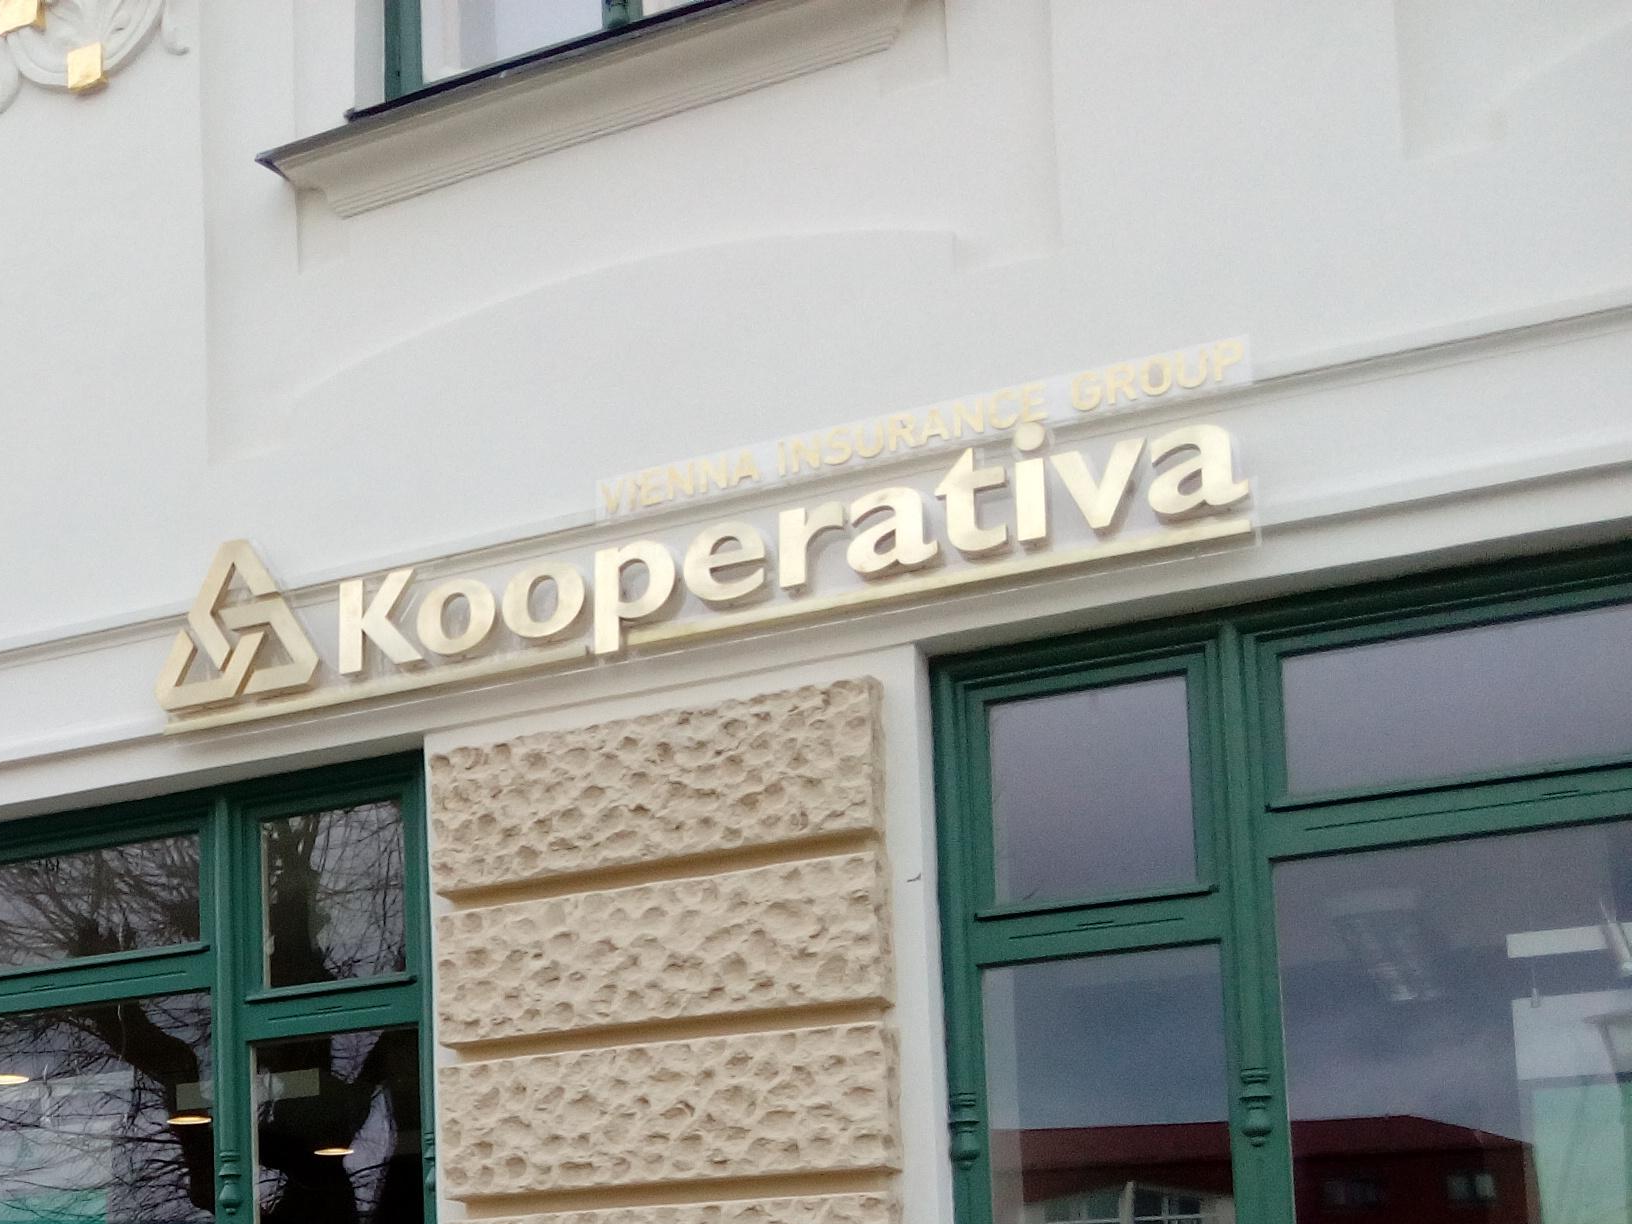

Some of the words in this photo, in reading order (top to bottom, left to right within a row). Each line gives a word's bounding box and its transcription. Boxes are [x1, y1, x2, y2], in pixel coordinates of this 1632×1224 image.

[601, 448, 761, 514] VIENNA
[775, 381, 1050, 478] INSURANCE
[1070, 336, 1248, 414] GROUP
[334, 420, 1256, 676] Kooperativa
